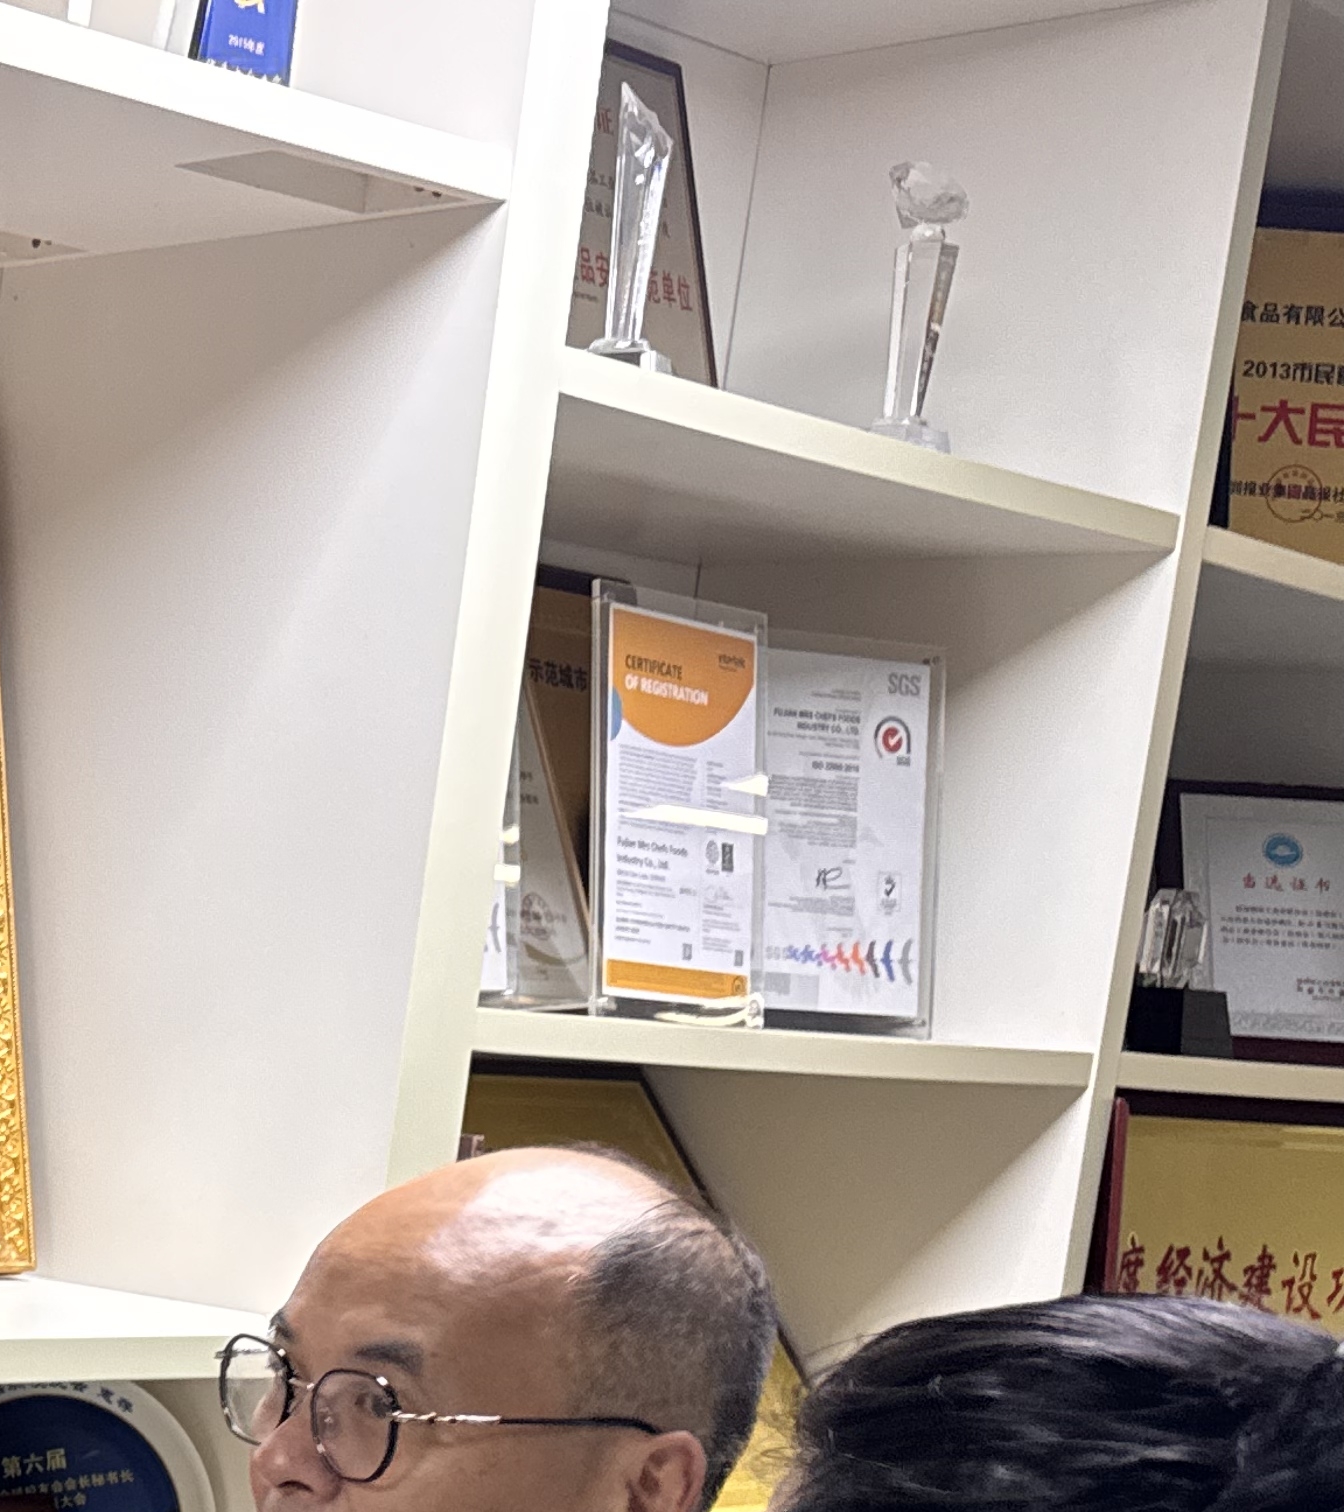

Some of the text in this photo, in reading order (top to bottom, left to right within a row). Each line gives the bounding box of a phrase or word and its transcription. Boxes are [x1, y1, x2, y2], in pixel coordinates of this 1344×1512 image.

[625, 654, 683, 681] CERTIFICATE
[625, 673, 709, 706] OF REGISTRATION
[888, 672, 921, 696] SGS
[1, 1447, 68, 1479] 第六届
